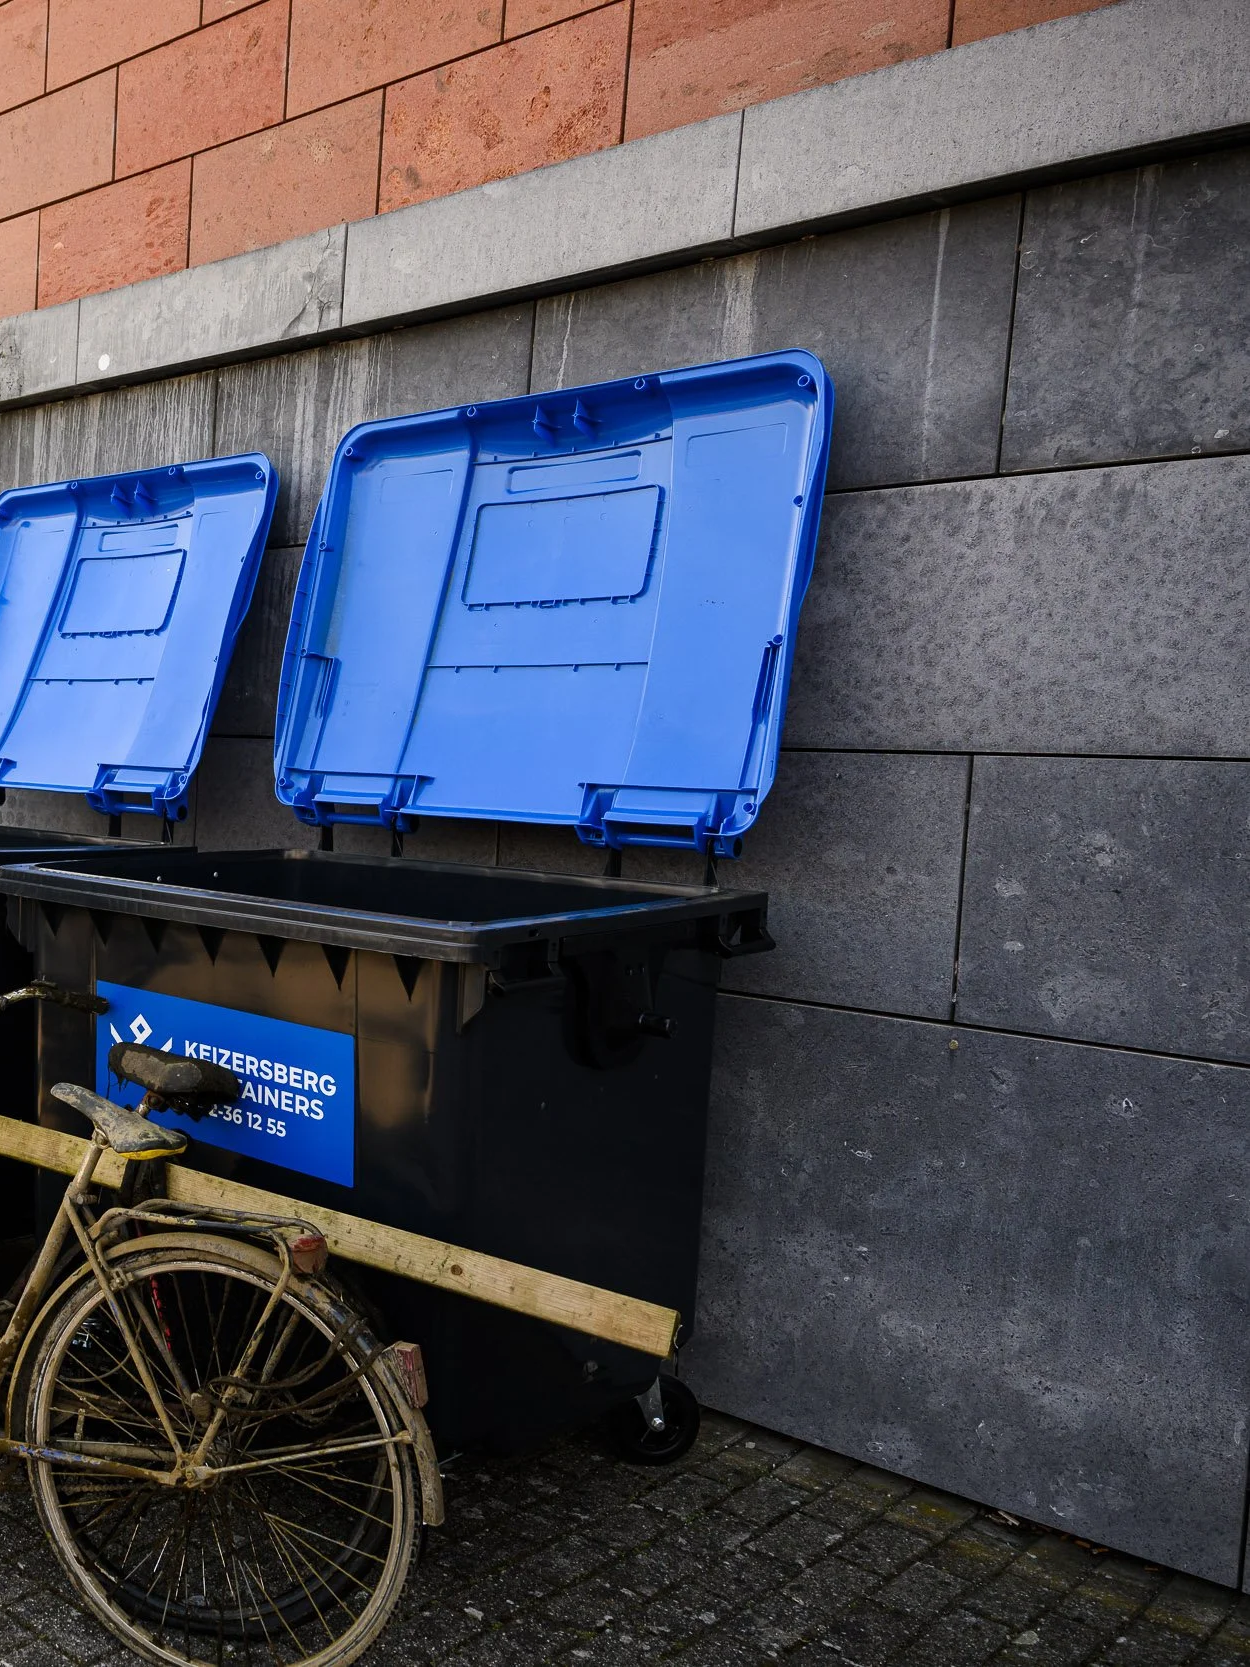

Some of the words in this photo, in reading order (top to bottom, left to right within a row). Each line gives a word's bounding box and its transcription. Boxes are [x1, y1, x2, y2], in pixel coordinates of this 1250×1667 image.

[184, 1040, 337, 1097] KEIZERSBERG
[208, 1103, 243, 1125] 2-36
[246, 1111, 263, 1131] 12
[266, 1118, 287, 1138] 55
[240, 1079, 325, 1121] AINERS
